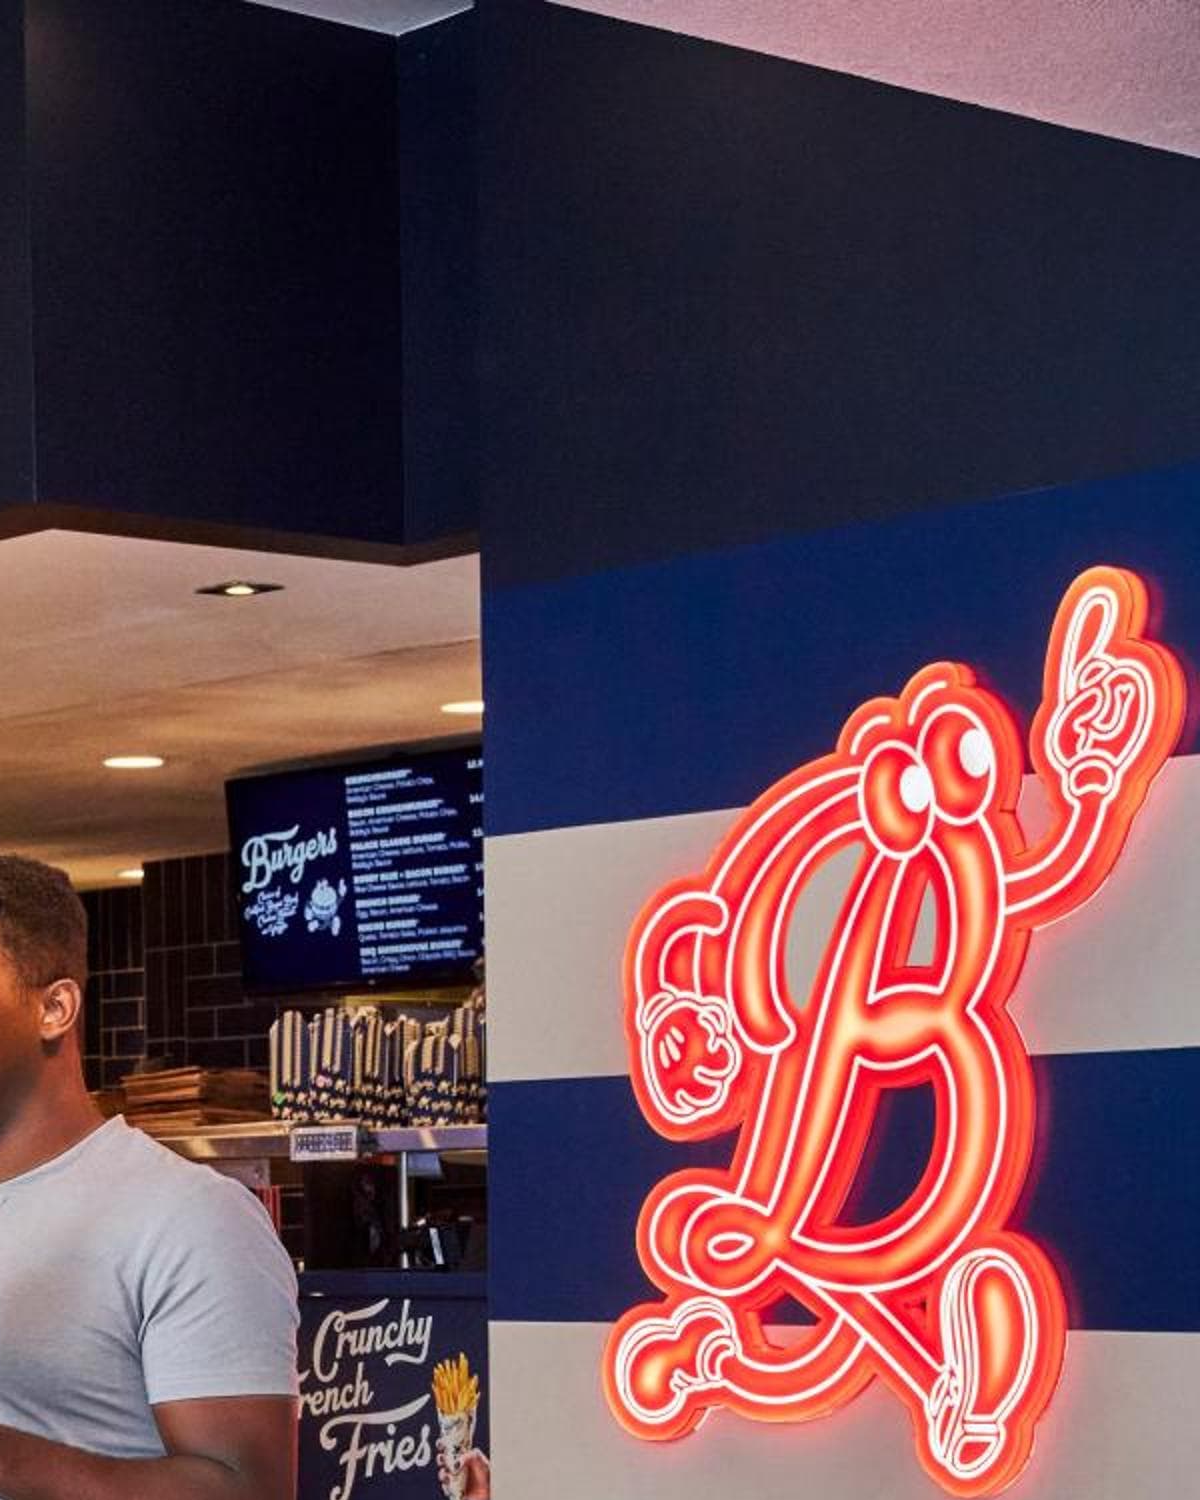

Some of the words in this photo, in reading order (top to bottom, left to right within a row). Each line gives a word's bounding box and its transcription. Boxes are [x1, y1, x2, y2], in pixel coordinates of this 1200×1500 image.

[242, 824, 337, 892] Burgers
[313, 1298, 432, 1383] Crunchy
[298, 1362, 375, 1420] rench
